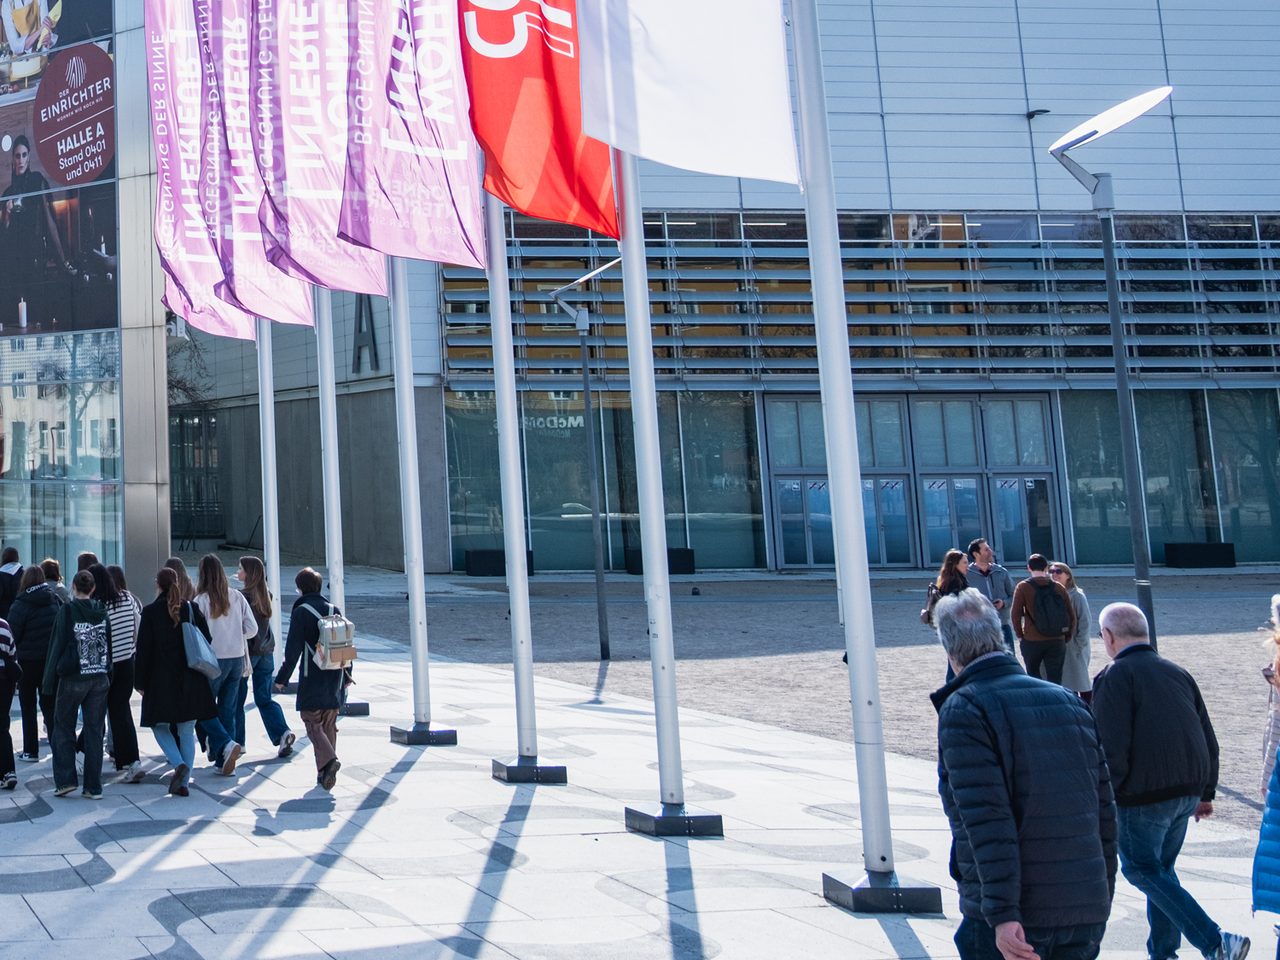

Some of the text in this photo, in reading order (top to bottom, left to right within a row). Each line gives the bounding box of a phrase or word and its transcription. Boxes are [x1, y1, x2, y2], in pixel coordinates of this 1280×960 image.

[40, 76, 112, 123] EINRICHTER
[58, 88, 70, 99] DER
[57, 122, 105, 156] HALLE A
[58, 138, 107, 170] Stand 0401
[65, 156, 103, 182] und 0411
